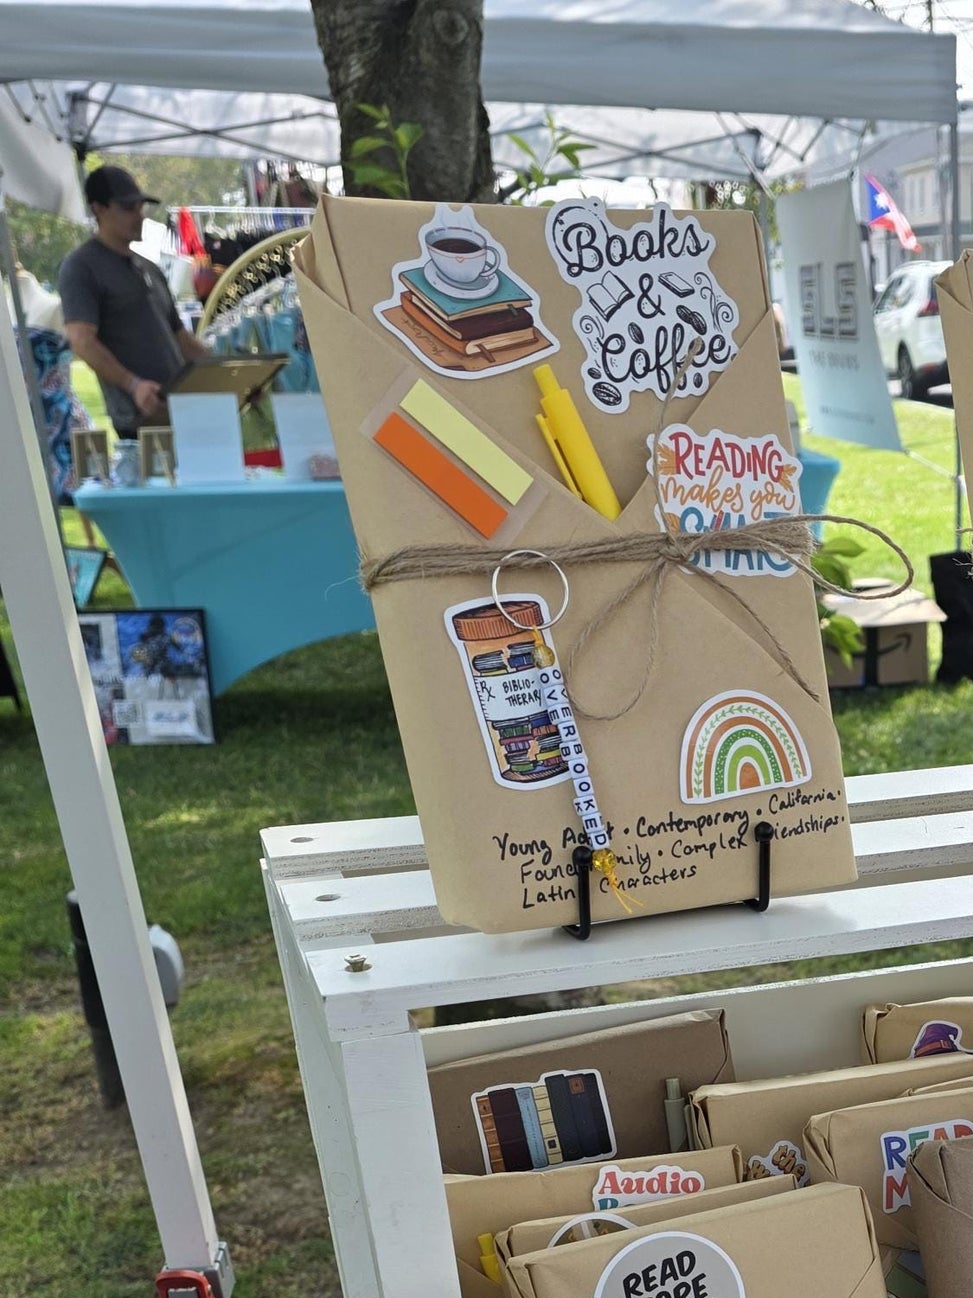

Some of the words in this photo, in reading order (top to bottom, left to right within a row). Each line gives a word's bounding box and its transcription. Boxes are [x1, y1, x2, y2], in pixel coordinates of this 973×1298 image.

[562, 207, 710, 278] Books
[637, 273, 666, 319] &
[600, 319, 733, 400] Coffee
[668, 431, 784, 483] READING
[660, 465, 744, 513] makes
[751, 481, 796, 521] you
[539, 667, 608, 849] OVERBOOKED
[493, 831, 552, 865] Young
[636, 808, 750, 839] Contemporary
[670, 834, 748, 859] Complex
[598, 1170, 703, 1195] Audio
